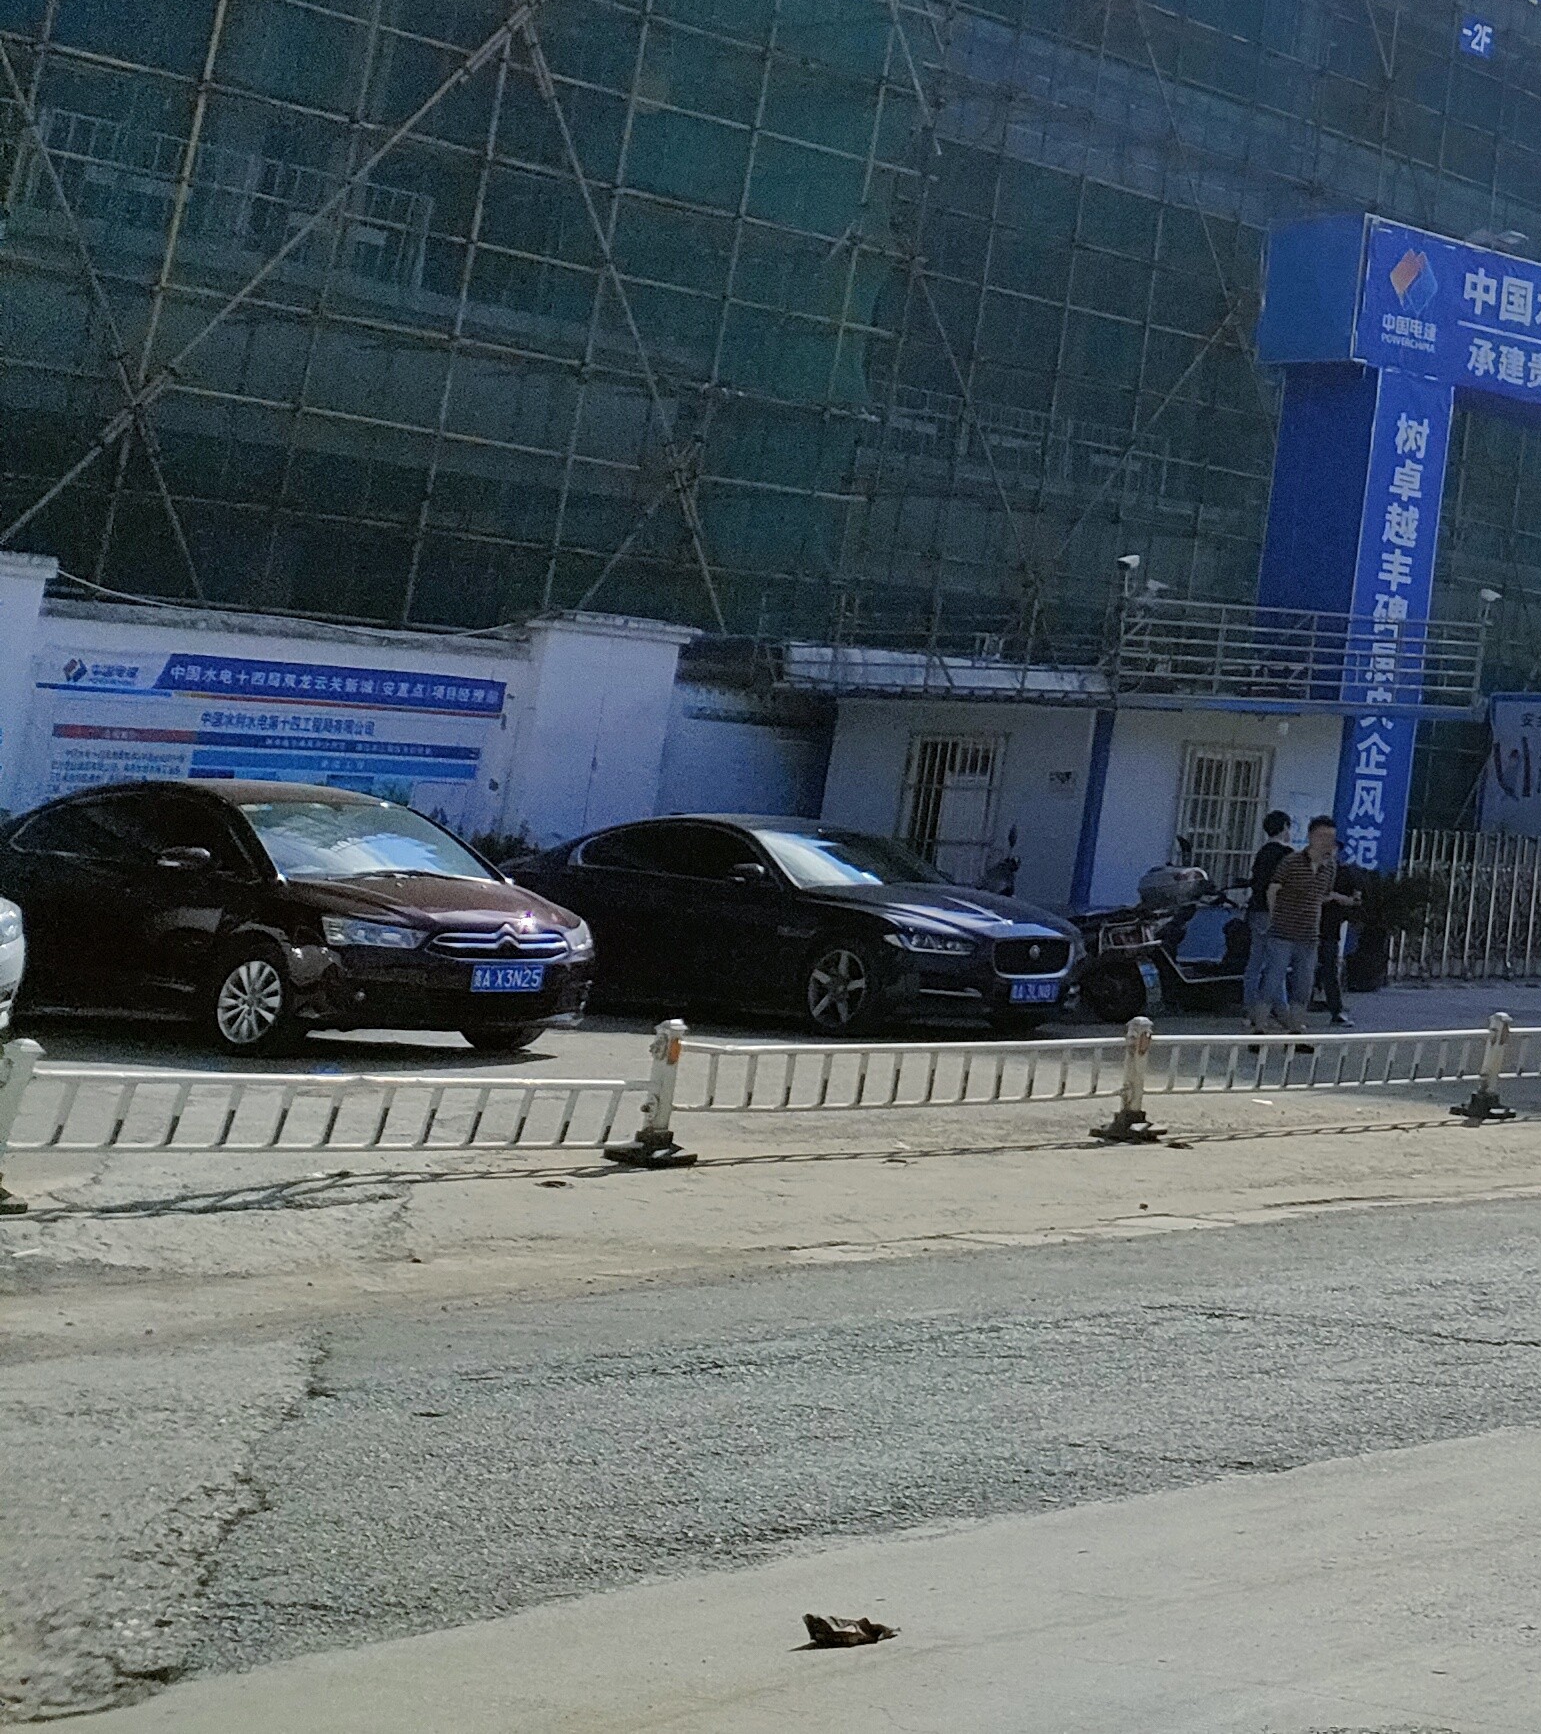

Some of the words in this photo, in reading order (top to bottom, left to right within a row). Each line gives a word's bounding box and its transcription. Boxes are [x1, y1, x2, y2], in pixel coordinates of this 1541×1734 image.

[1461, 25, 1493, 53] -2F
[1382, 313, 1437, 342] 中国电建
